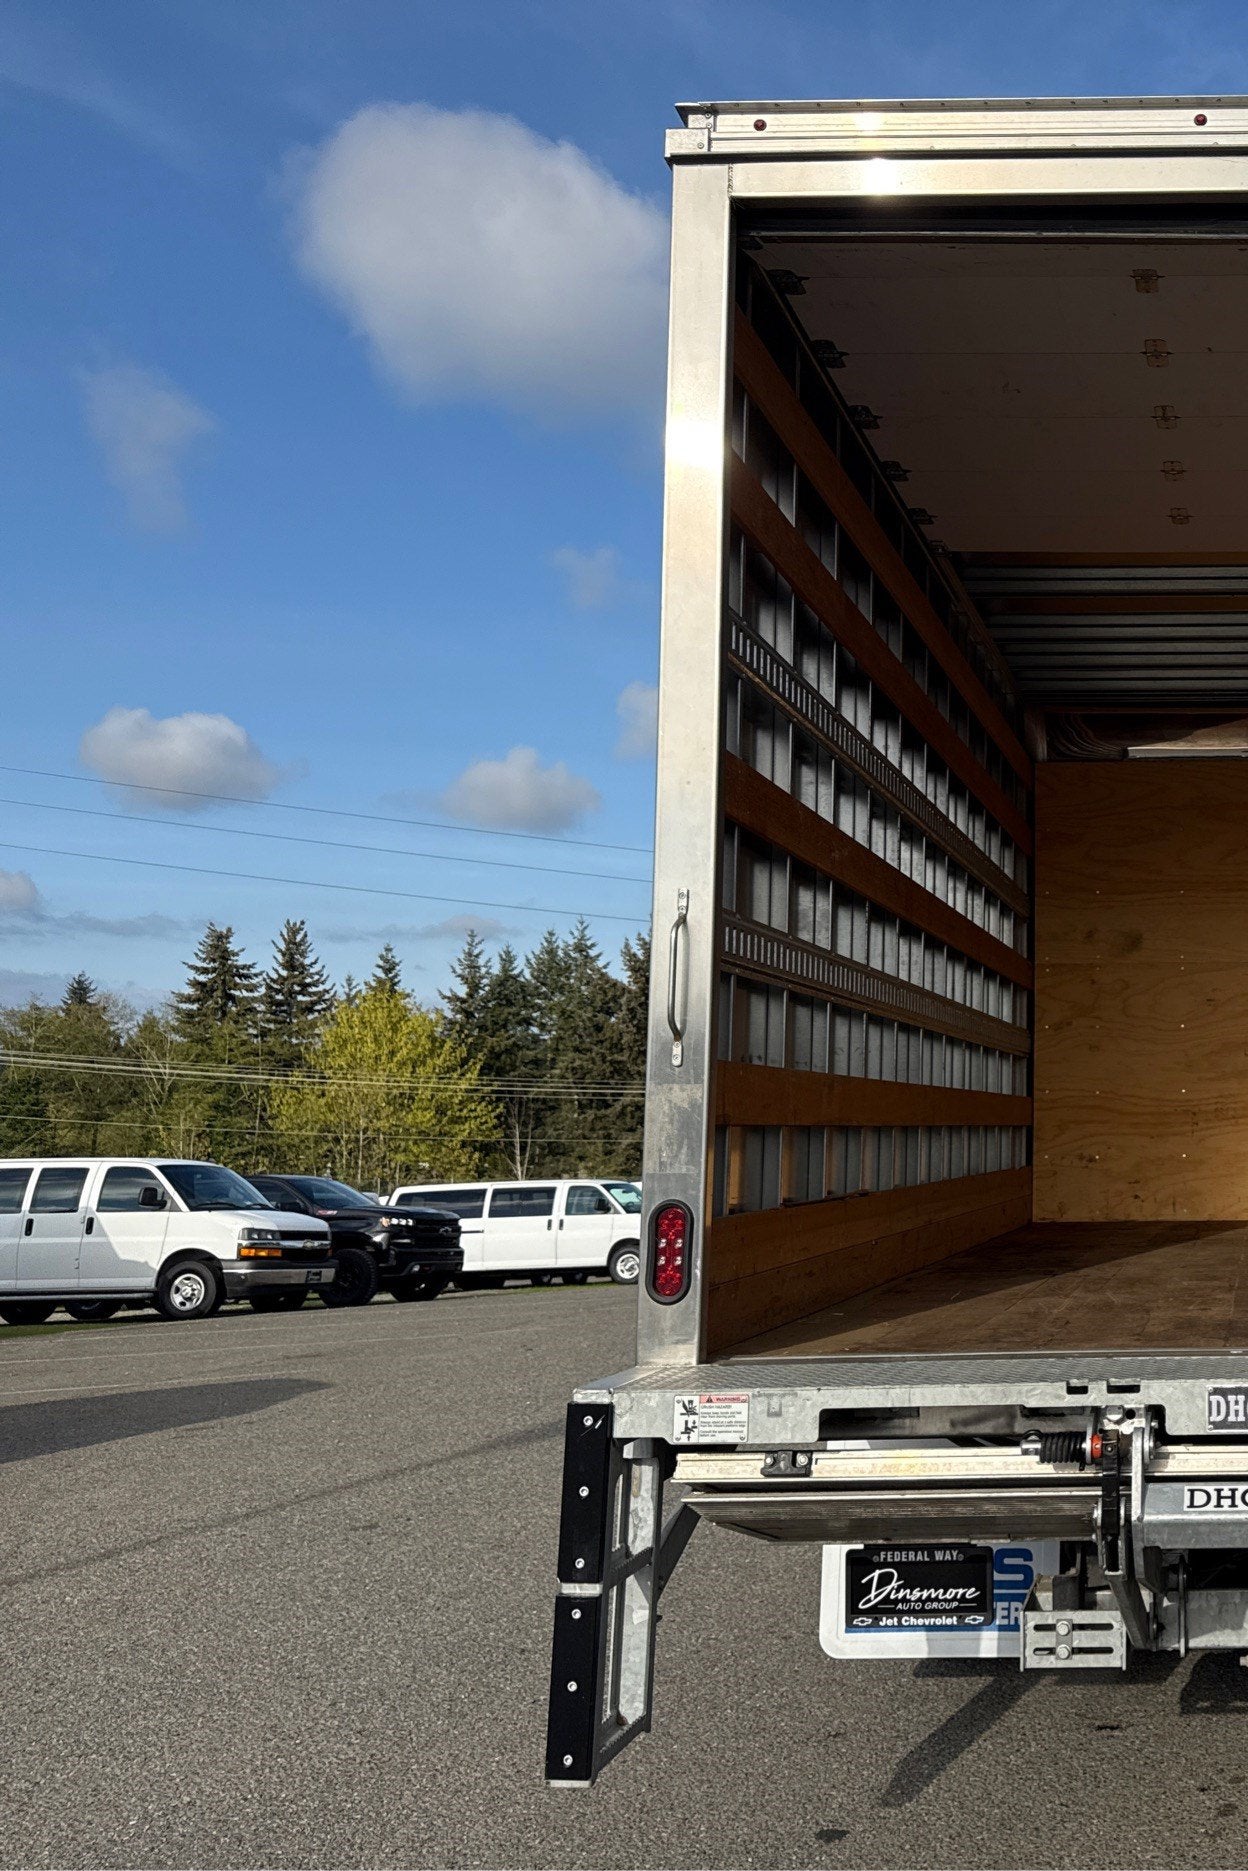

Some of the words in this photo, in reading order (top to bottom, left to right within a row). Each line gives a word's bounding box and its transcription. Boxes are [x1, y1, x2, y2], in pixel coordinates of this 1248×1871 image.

[880, 1550, 930, 1563] FEDERAL
[935, 1549, 959, 1561] WAY
[858, 1568, 981, 1610] Dinsmore
[896, 1602, 922, 1611] AUTO
[925, 1601, 960, 1610] GROUP
[879, 1616, 898, 1627] Jet
[901, 1615, 958, 1627] Chevrolet
